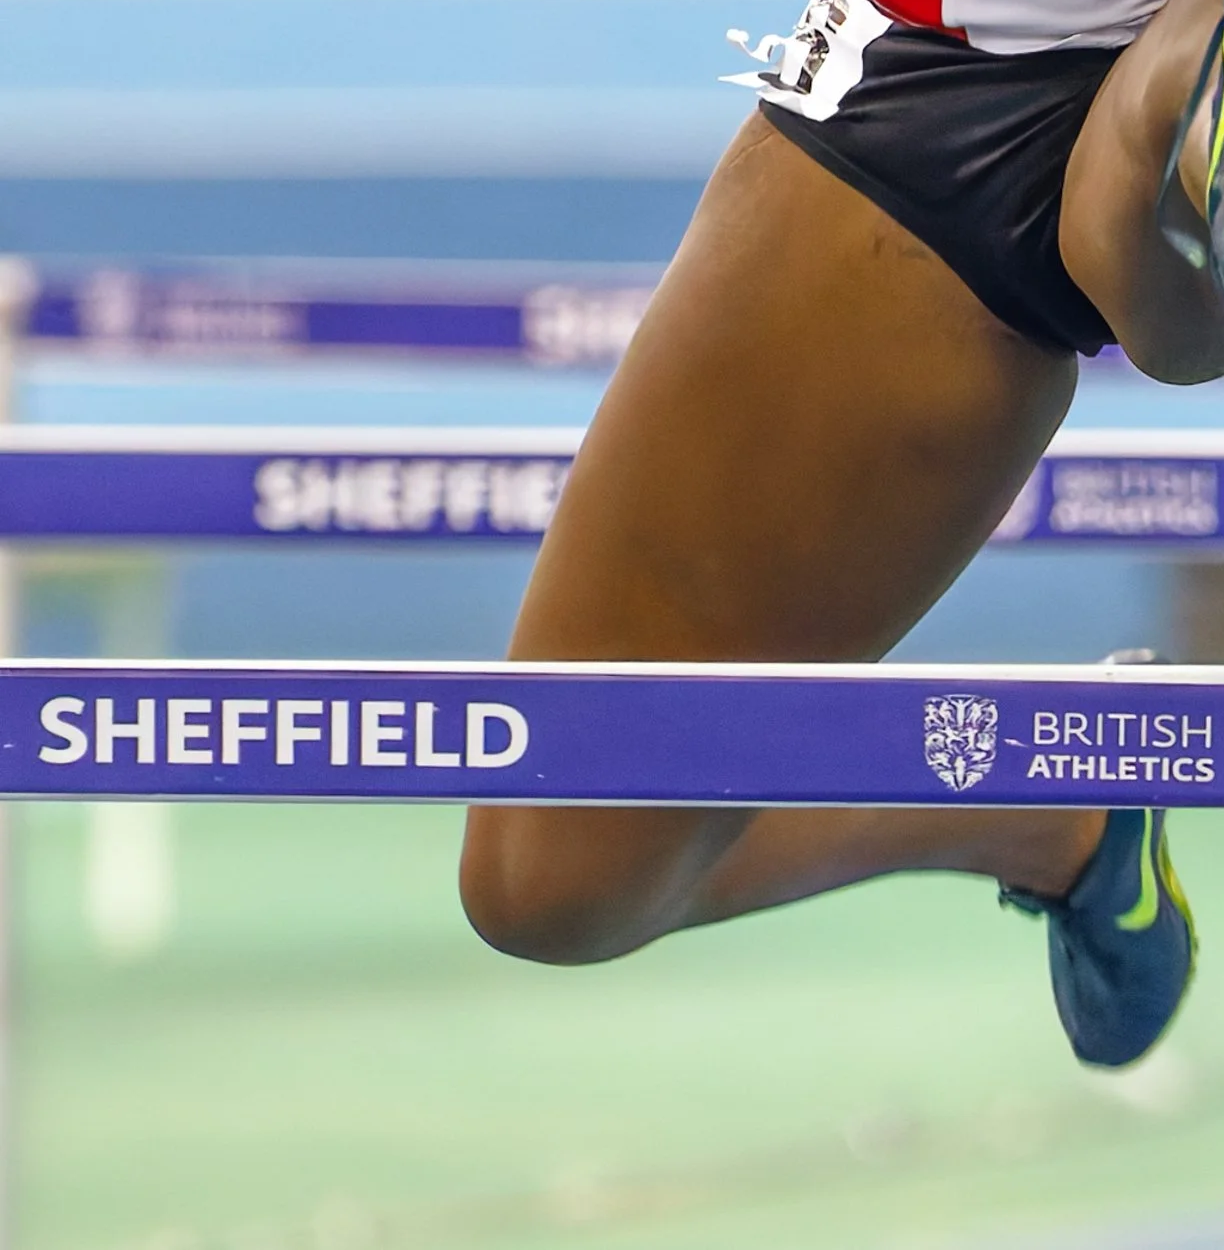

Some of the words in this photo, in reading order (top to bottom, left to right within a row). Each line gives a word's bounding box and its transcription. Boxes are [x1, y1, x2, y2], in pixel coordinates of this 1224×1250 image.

[38, 695, 530, 768] SHEFFIELD
[1033, 711, 1213, 749] BRITISH
[1026, 754, 1216, 783] ATHLETICS
